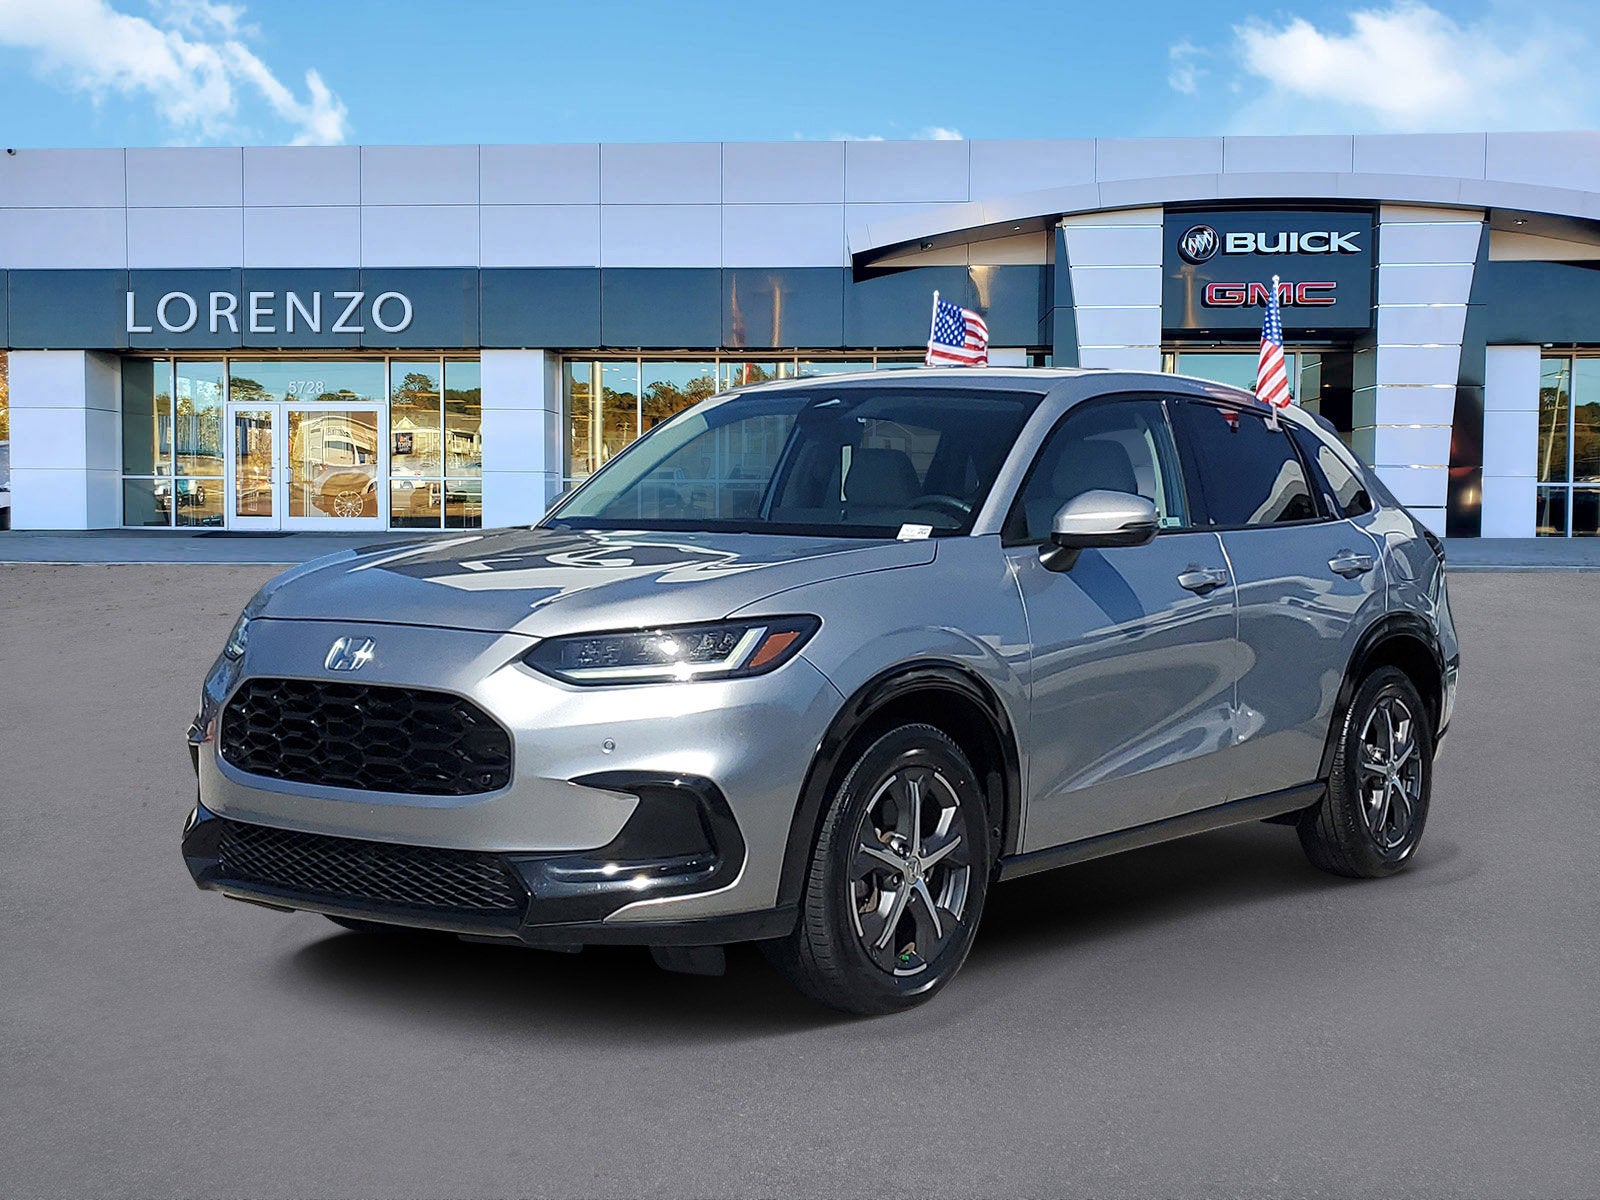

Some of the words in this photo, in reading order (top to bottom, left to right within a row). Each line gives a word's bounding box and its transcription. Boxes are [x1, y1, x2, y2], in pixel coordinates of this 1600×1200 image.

[1226, 231, 1362, 253] BUICK
[1205, 281, 1337, 306] GMC
[126, 291, 414, 333] LORENZO
[288, 381, 325, 394] 5728
